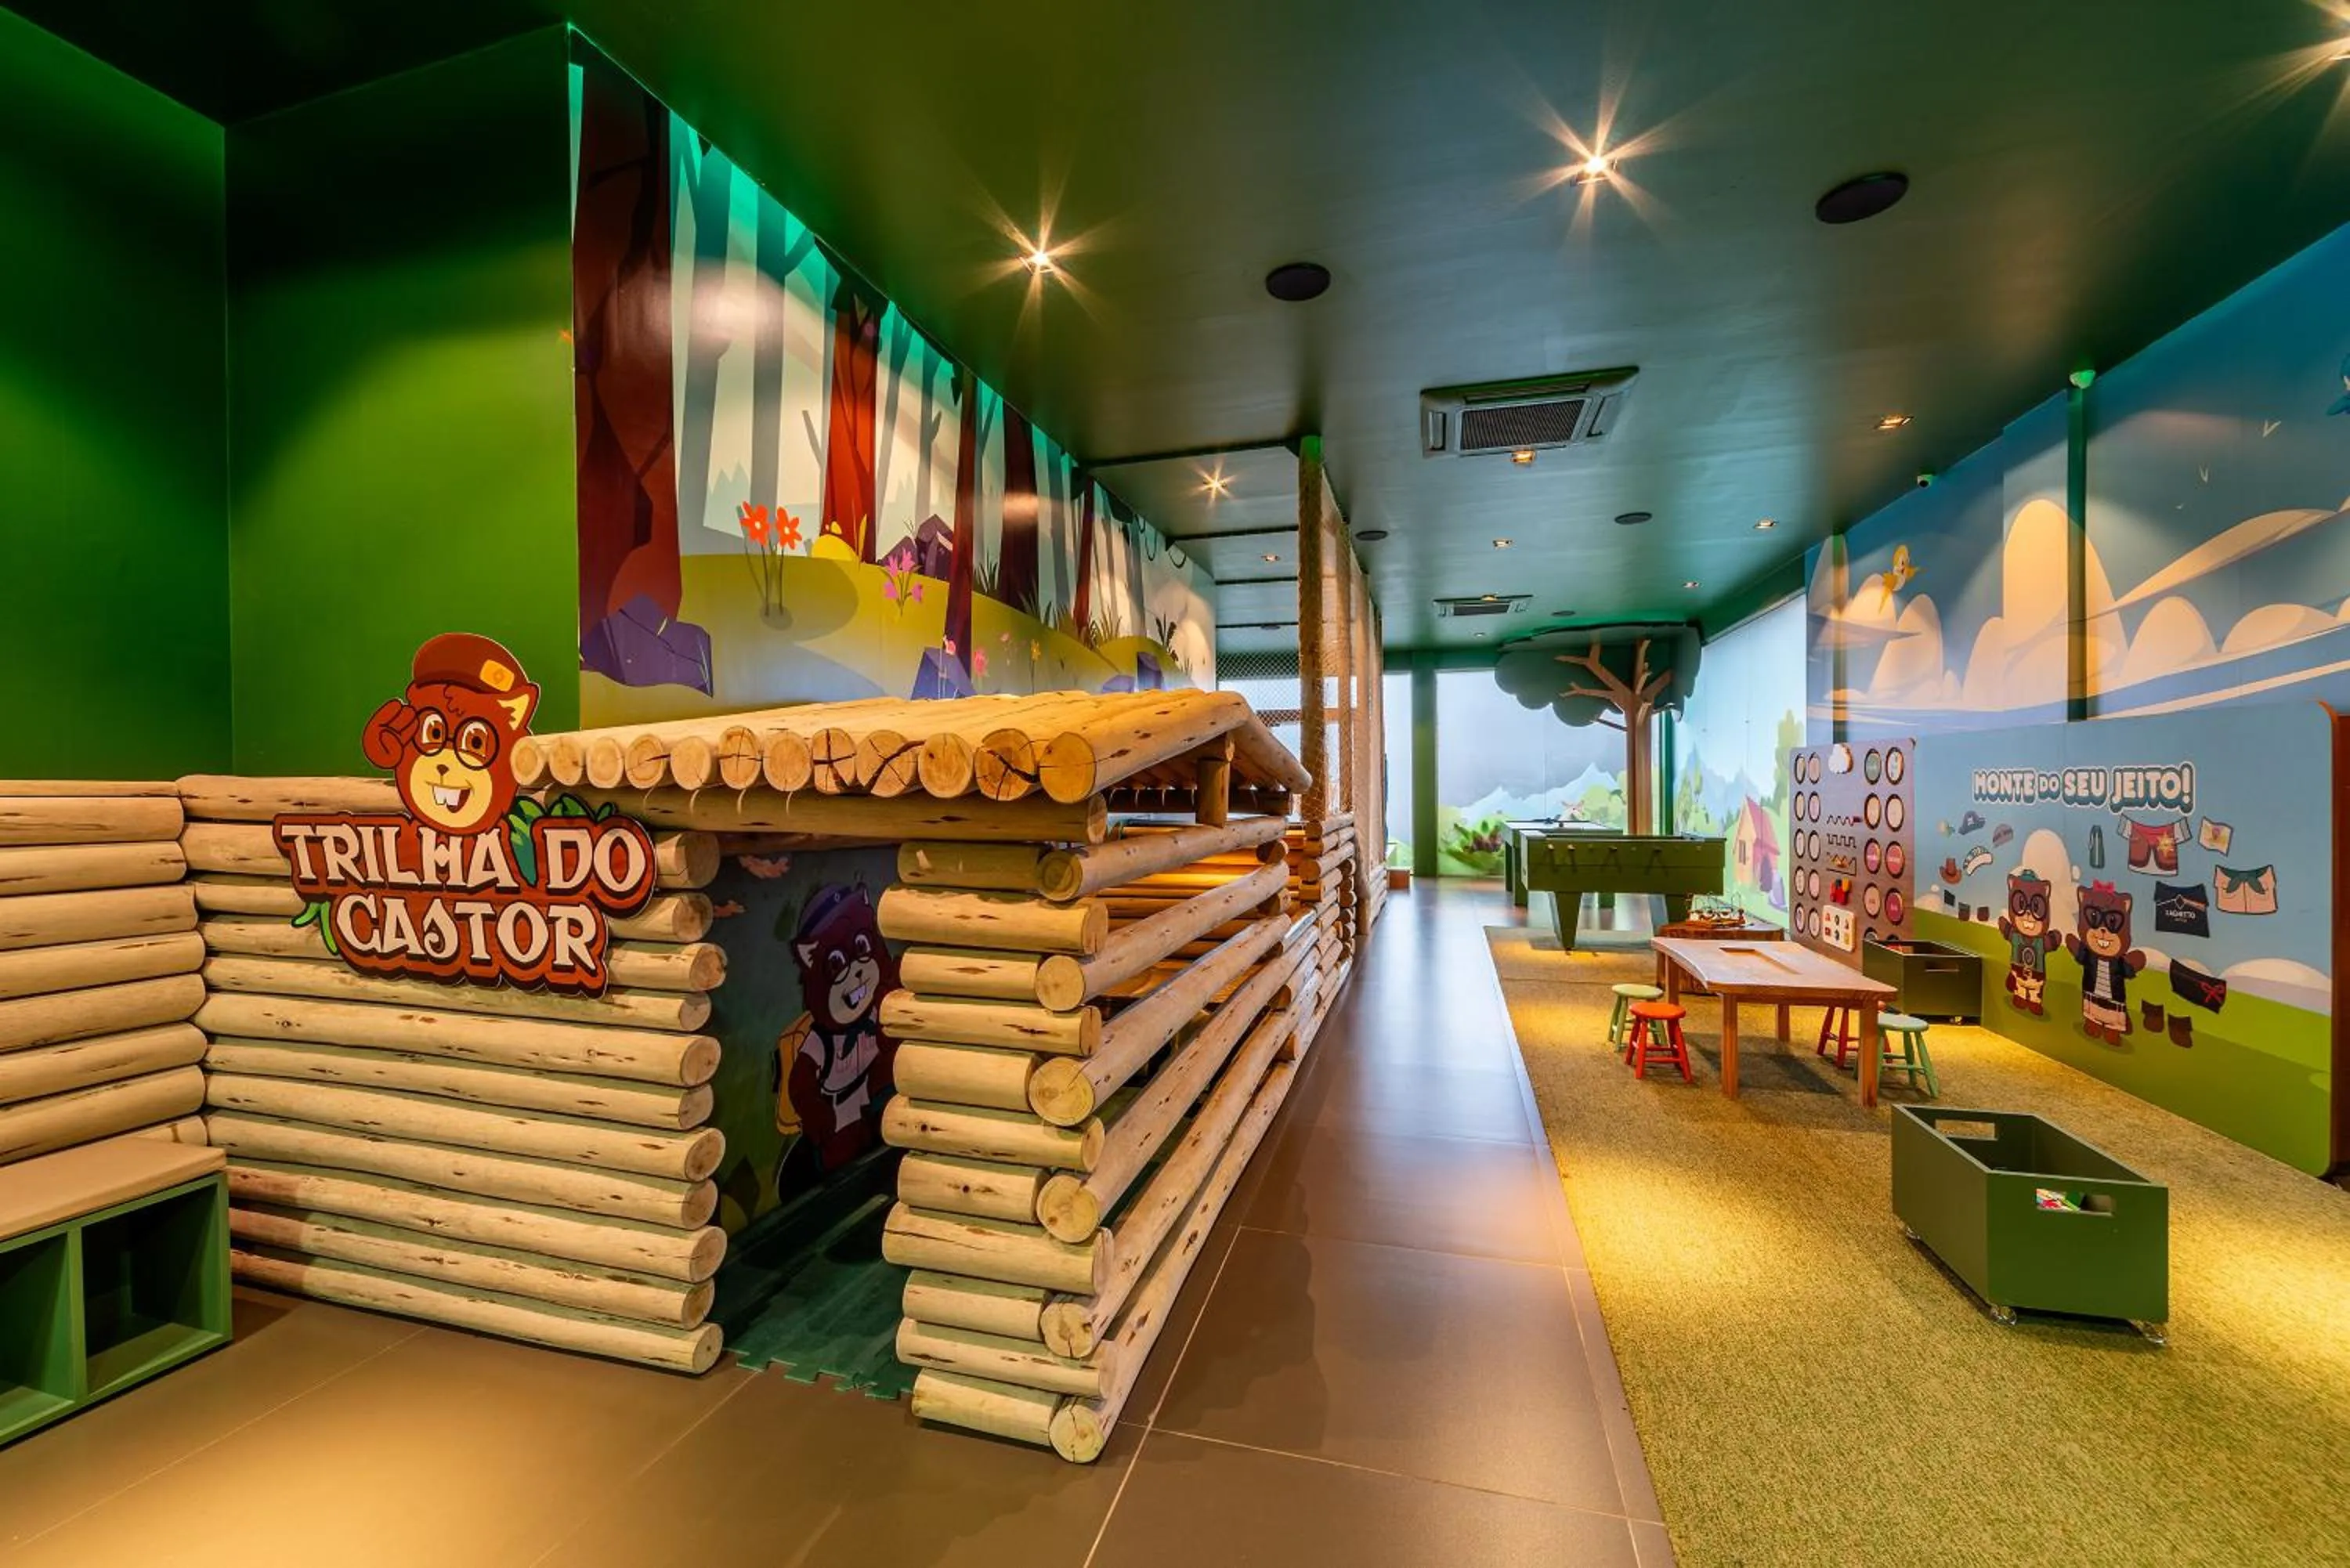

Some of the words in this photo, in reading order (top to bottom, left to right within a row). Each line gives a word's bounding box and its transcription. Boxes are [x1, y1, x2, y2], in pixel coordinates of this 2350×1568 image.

[1974, 771, 2034, 795] MONTE
[2039, 774, 2058, 793] DO
[2064, 769, 2106, 797] SEU
[2112, 767, 2191, 804] JEITO!
[282, 823, 519, 891] TRILHA
[544, 828, 645, 892] DO
[335, 893, 597, 972] CASTOR
